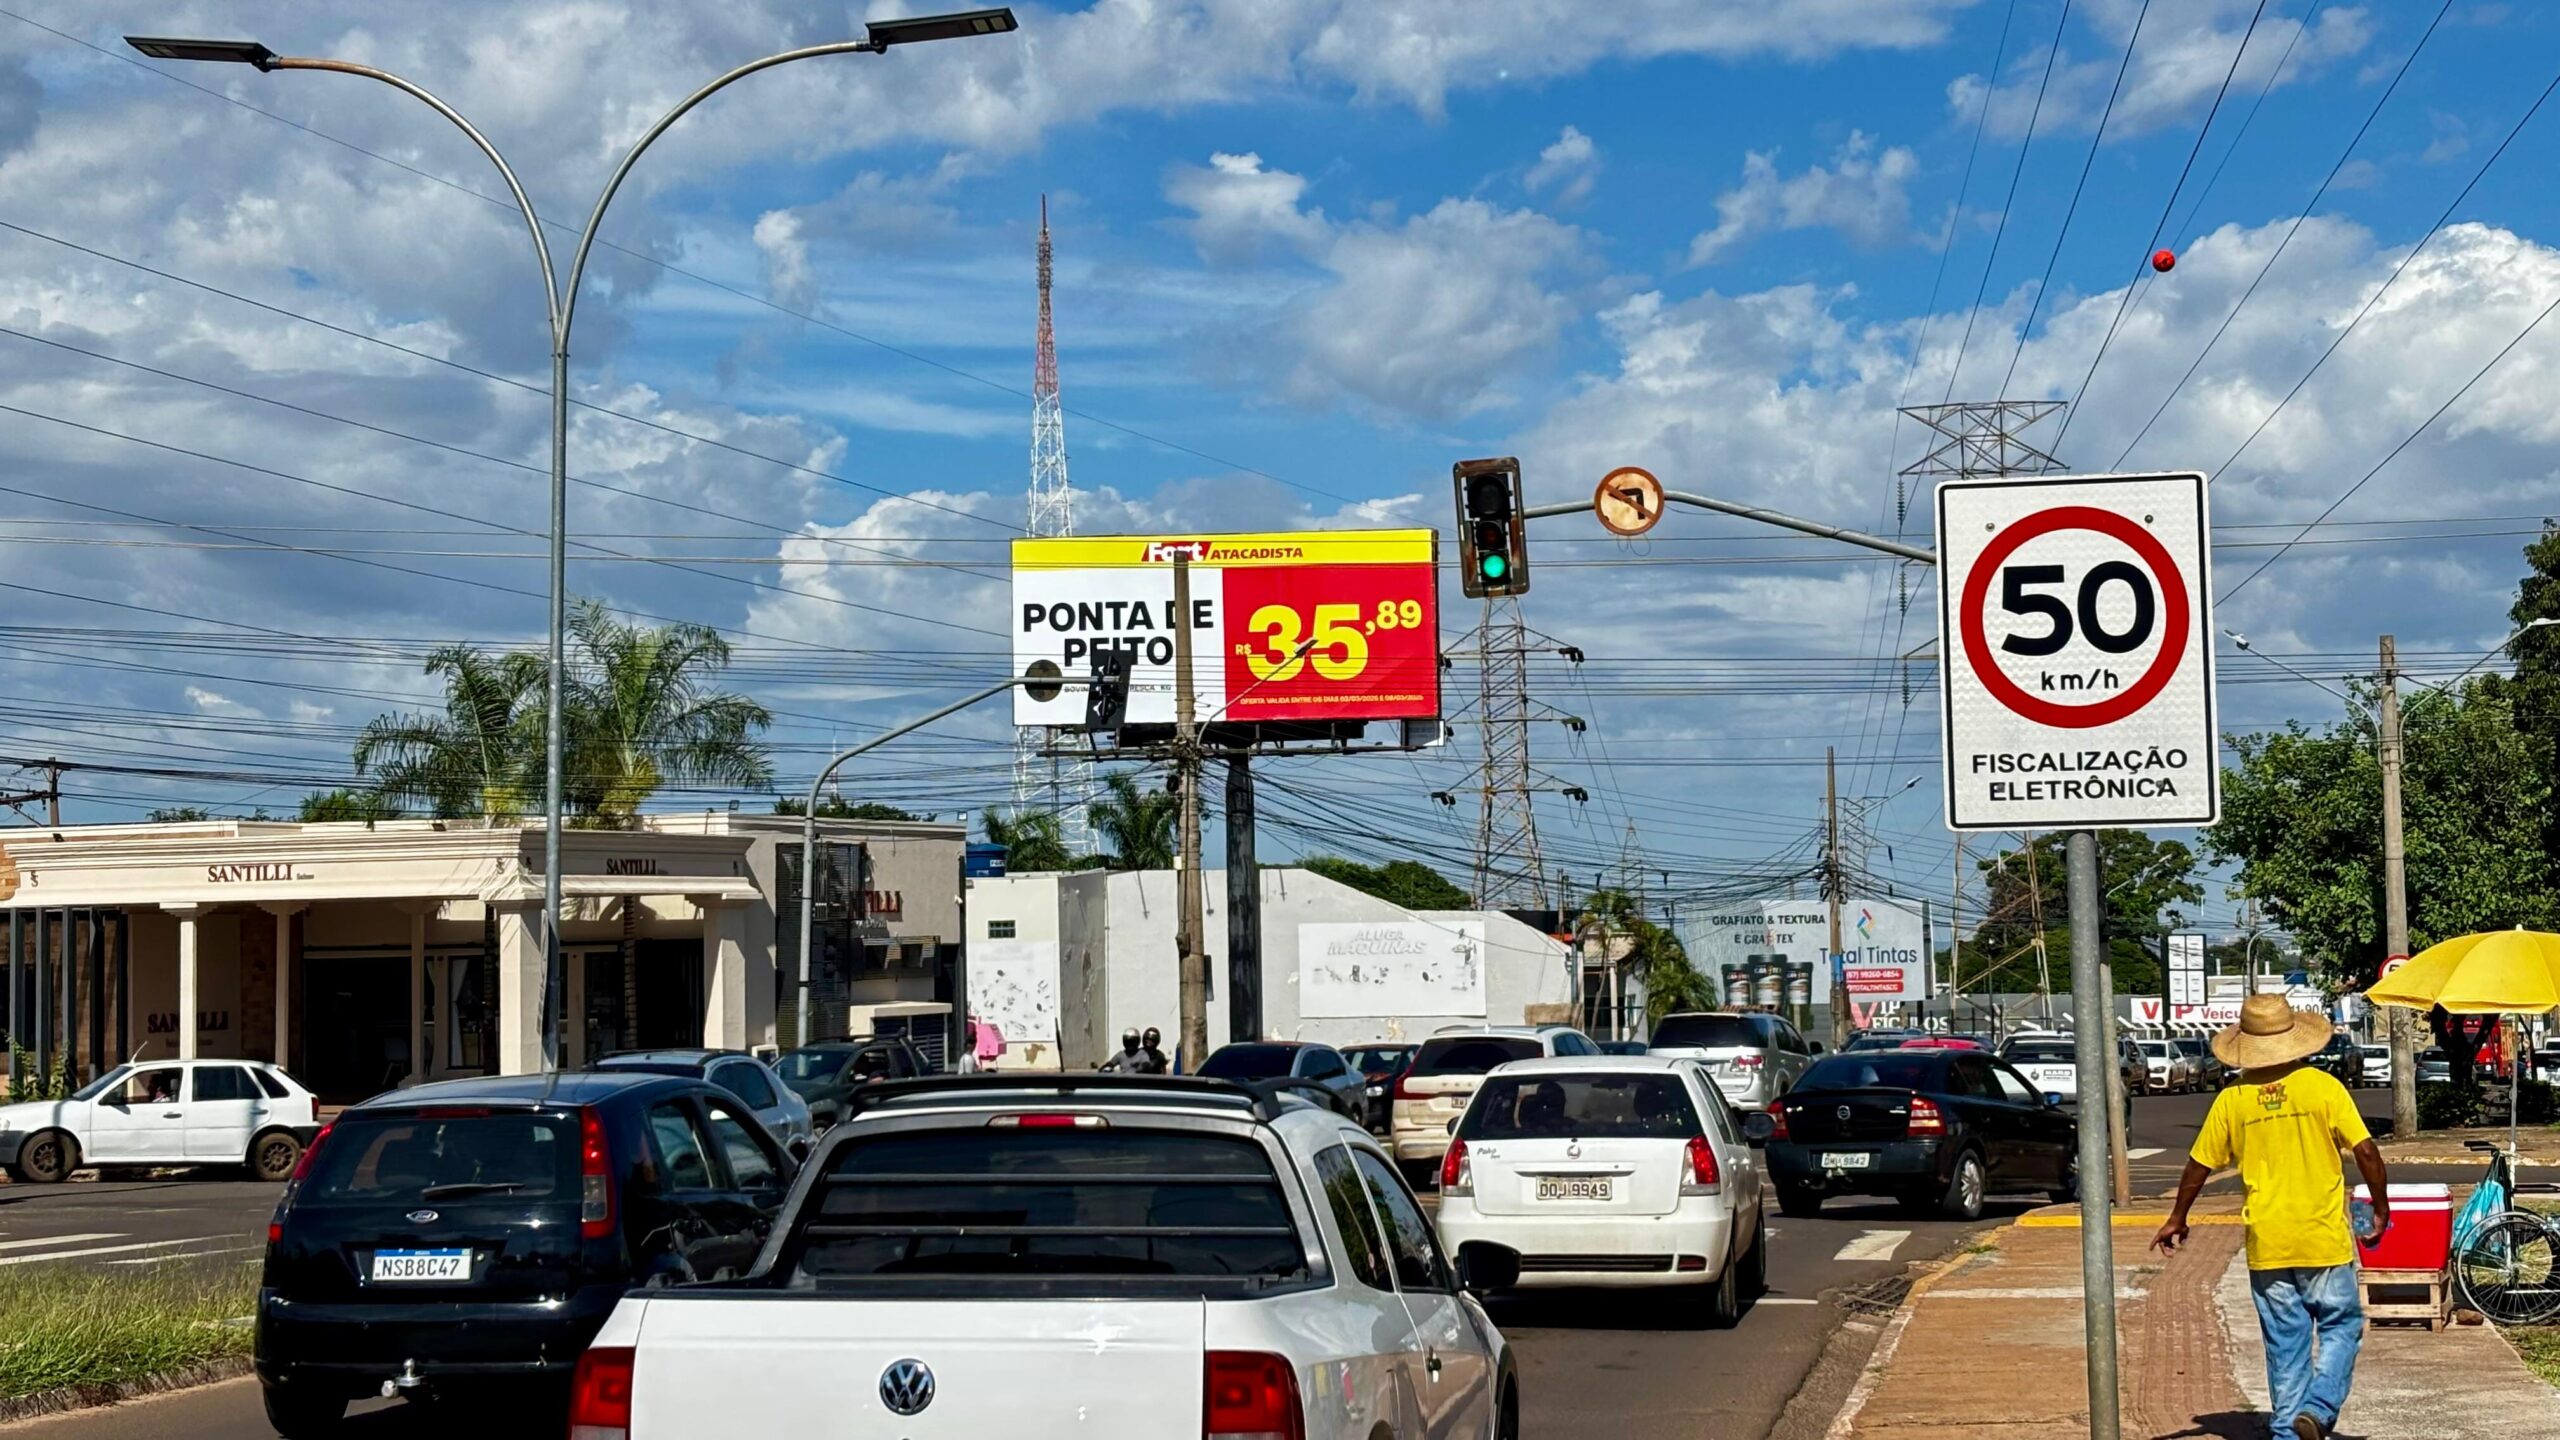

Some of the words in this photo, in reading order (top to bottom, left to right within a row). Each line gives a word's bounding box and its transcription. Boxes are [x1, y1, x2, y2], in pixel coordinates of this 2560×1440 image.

[1210, 548, 1303, 560] ATACADISTA
[1023, 601, 1155, 632] PONTA
[2001, 561, 2155, 656] 50
[1235, 643, 1252, 655] R$
[1247, 600, 1422, 681] 35,89
[1130, 684, 1155, 692] RESCA
[2041, 669, 2119, 691] km/h
[1972, 745, 2188, 775] FISCALIZAÇÃO
[1989, 775, 2178, 801] ELETRÔNICA
[207, 863, 293, 882] SANTILLI
[606, 858, 656, 875] SANTILLI
[1712, 915, 1764, 926] GRAFIATO
[1767, 915, 1775, 924] &
[1777, 915, 1826, 925] TEXTURA
[1734, 934, 1742, 943] E
[1819, 946, 1862, 964] Ttal
[1866, 946, 1918, 964] Tintas
[2141, 1002, 2194, 1019] VP
[1571, 1183, 1608, 1197] 9949
[382, 1258, 461, 1277] NSB8C47
